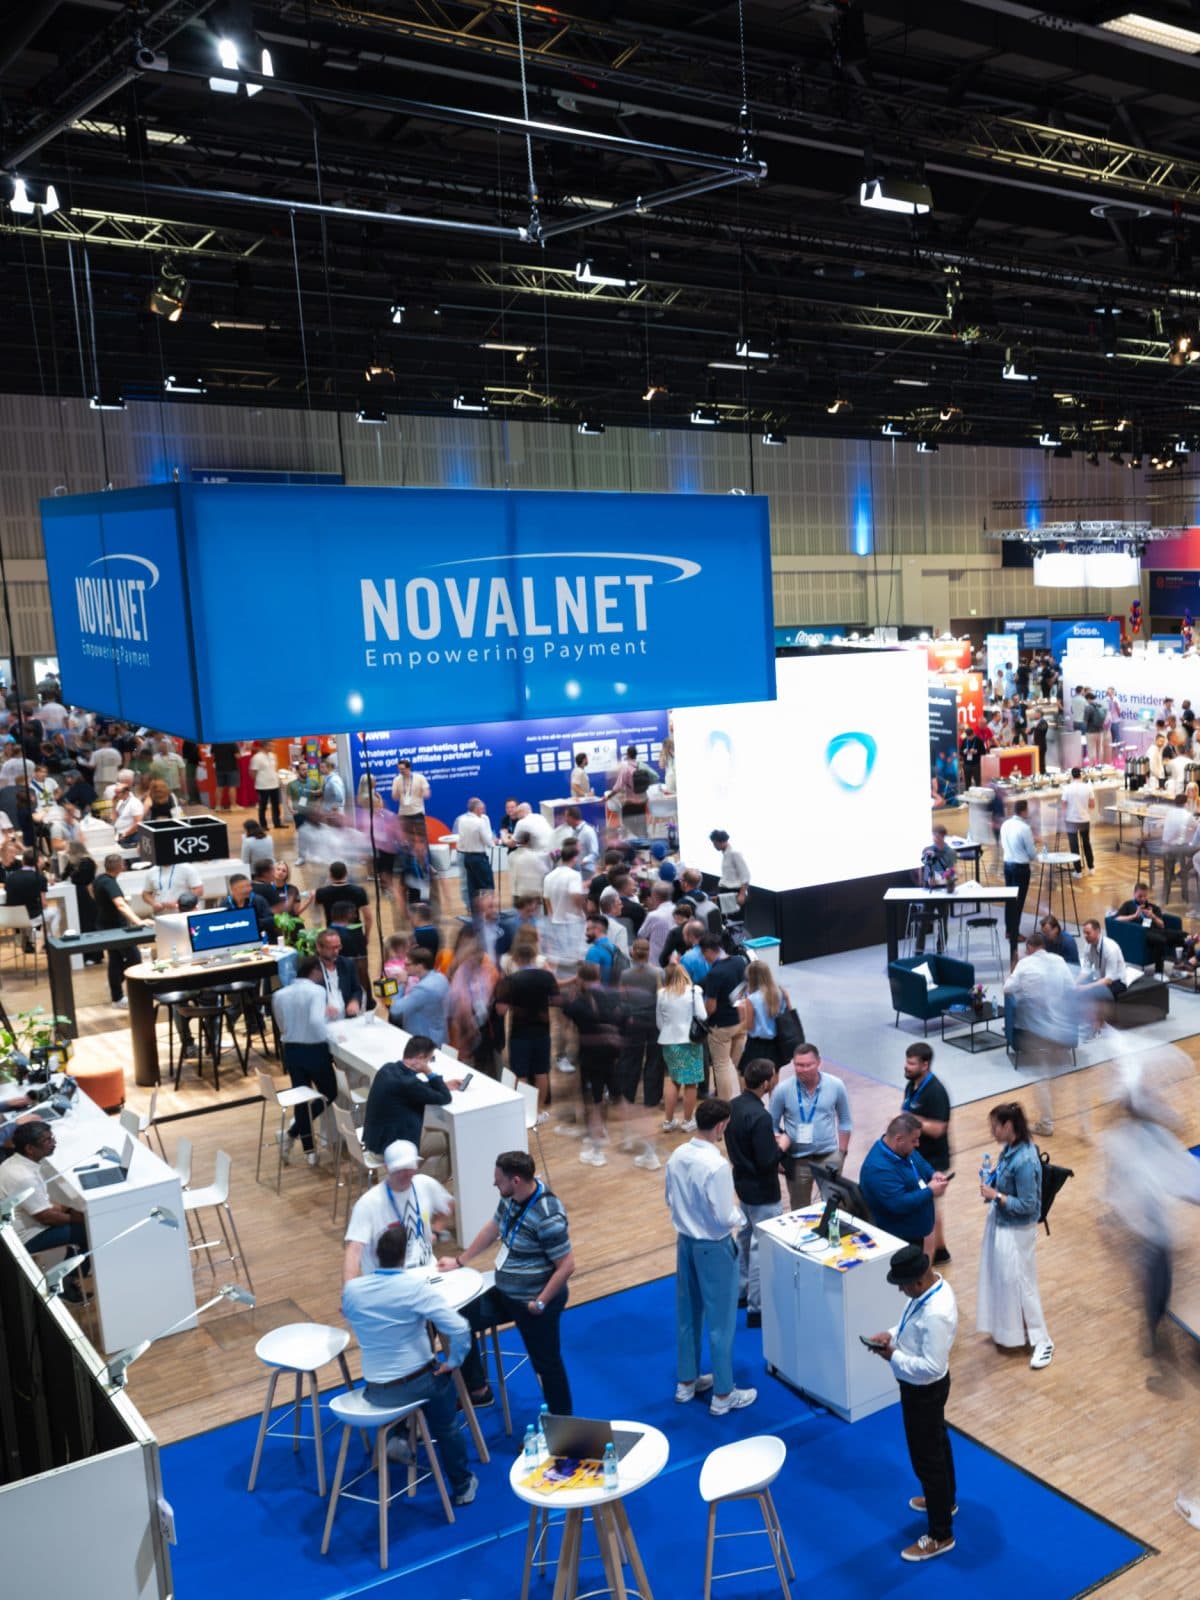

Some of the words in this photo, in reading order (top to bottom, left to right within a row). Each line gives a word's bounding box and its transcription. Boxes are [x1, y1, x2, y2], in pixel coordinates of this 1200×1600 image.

[75, 576, 149, 642] NOVALNET
[360, 575, 654, 642] NOVALNET
[1072, 626, 1100, 636] base.
[82, 638, 120, 666] Empowering
[120, 645, 151, 669] Payment
[366, 643, 535, 669] Empowering
[544, 639, 648, 662] Payment
[359, 748, 398, 758] Whatever
[399, 745, 417, 757] your
[418, 743, 457, 753] marketing
[459, 741, 479, 750] goal,
[412, 753, 441, 763] affiliate
[443, 751, 472, 762] partner
[473, 749, 483, 757] for
[485, 747, 493, 757] it.
[173, 834, 211, 856] KPS
